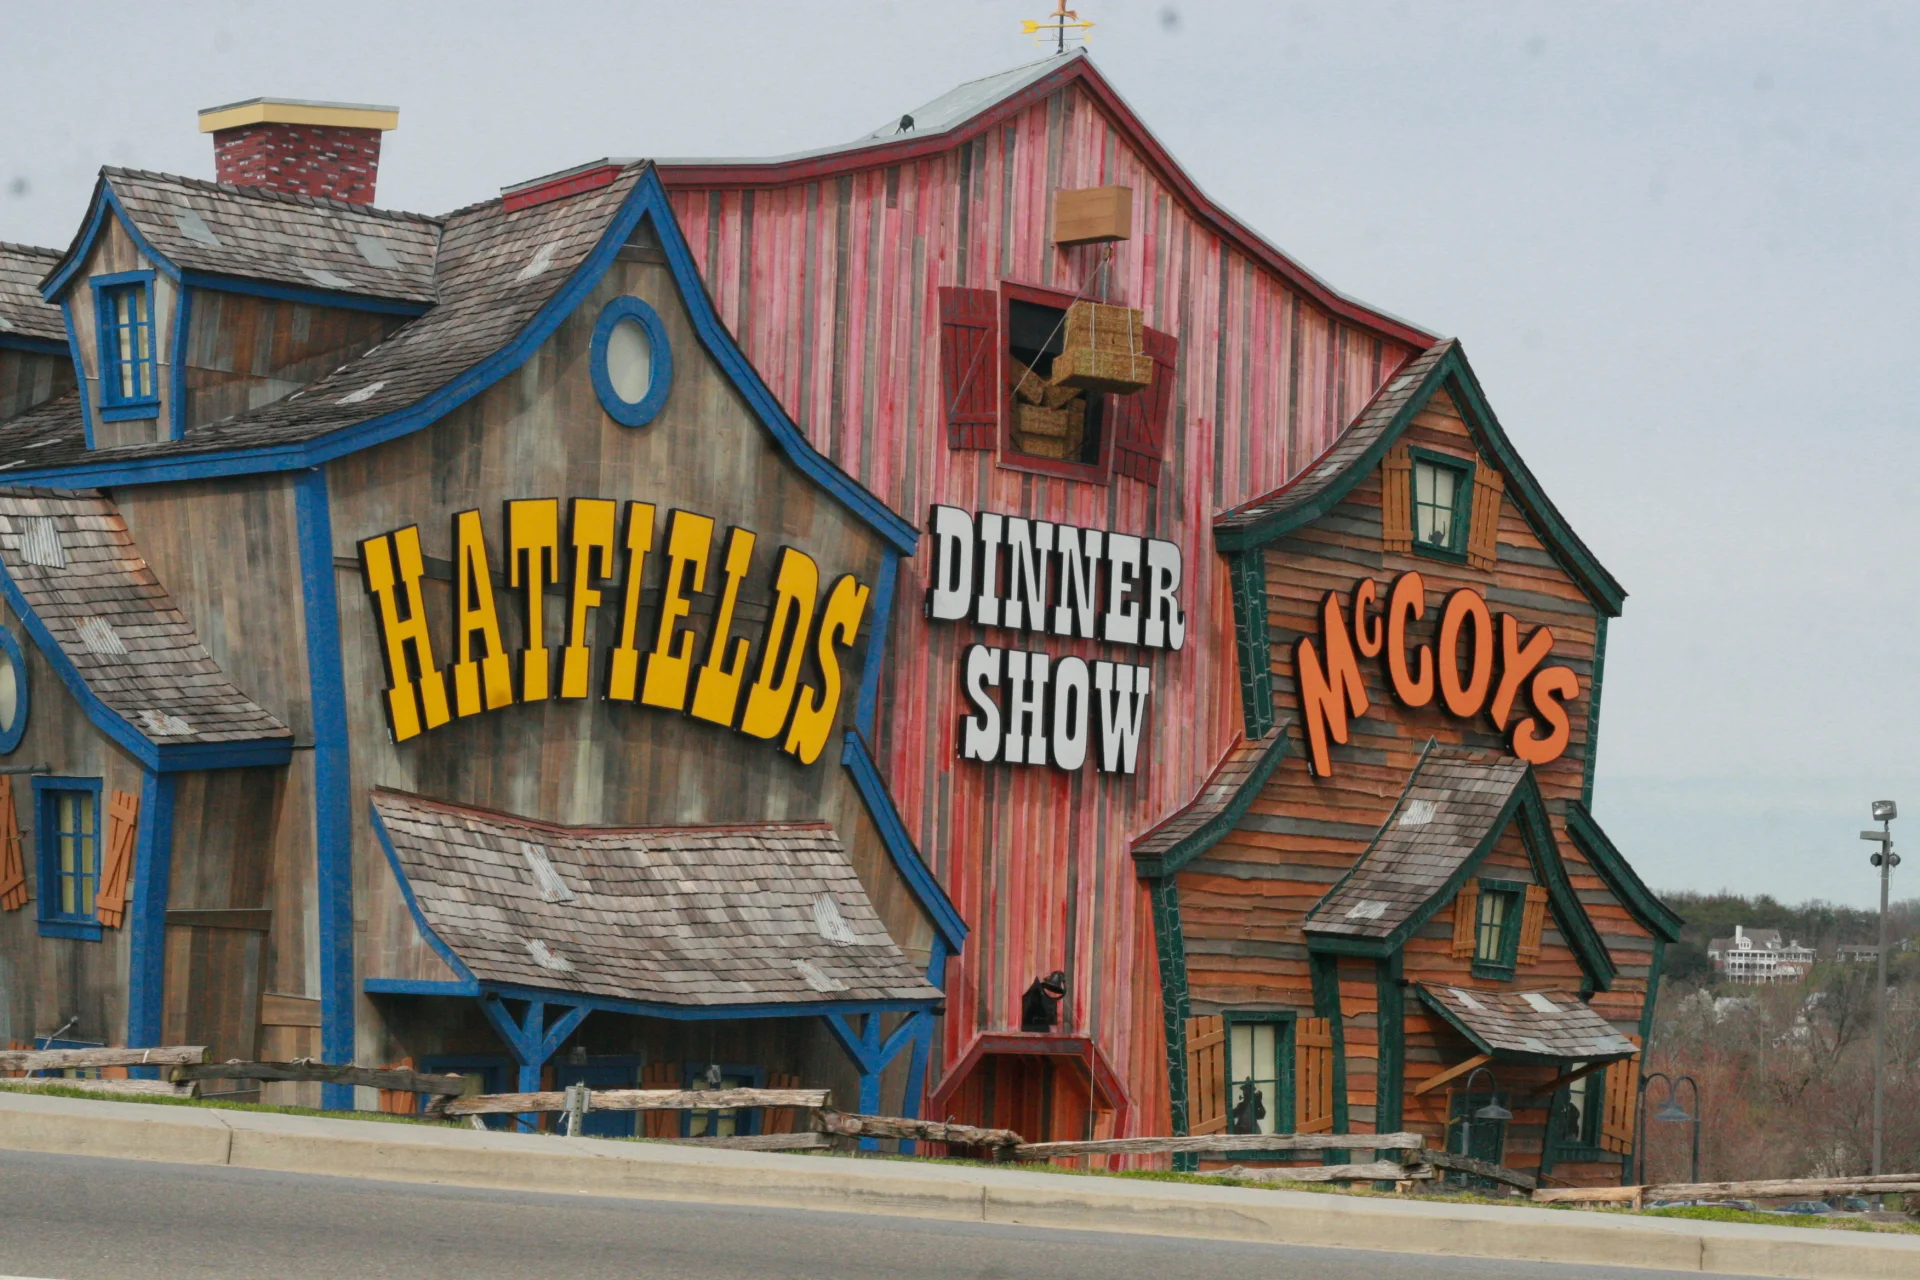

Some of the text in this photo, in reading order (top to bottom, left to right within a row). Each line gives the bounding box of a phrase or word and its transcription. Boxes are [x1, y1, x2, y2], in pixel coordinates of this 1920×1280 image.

[358, 497, 870, 765] HATFIELDS
[931, 505, 1186, 651] DINNER
[962, 644, 1150, 774] SHOW
